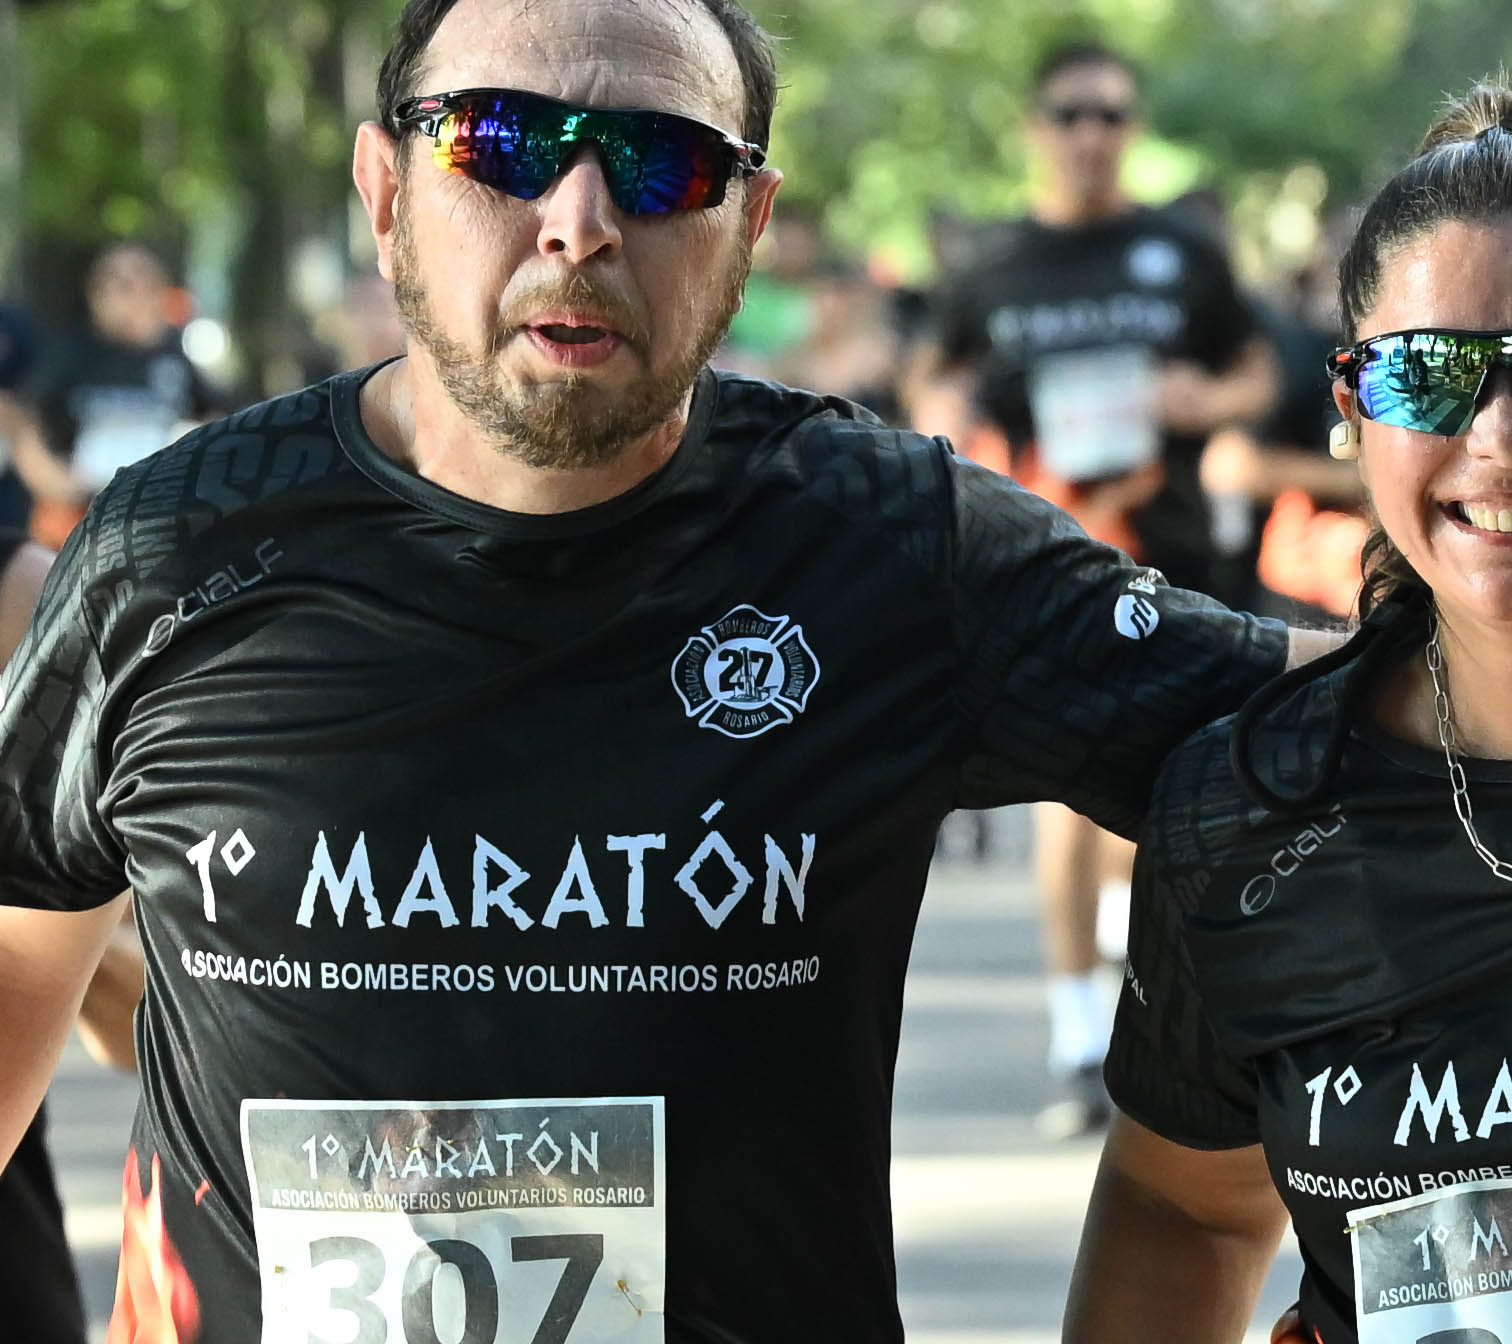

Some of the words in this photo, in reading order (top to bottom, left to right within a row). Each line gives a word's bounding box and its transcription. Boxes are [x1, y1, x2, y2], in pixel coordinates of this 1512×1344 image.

[718, 647, 774, 693] 27
[722, 710, 770, 729] ROSARIO
[295, 798, 817, 932] MARATÓN
[320, 962, 495, 992] BOMBEROS
[504, 964, 718, 993] VOLUNTARIOS
[726, 955, 820, 992] ROSARIO
[358, 1117, 600, 1179] MARATÓN
[271, 1188, 359, 1210] ASOCIACIÓN
[362, 1191, 451, 1210] BOMBEROS
[456, 1186, 567, 1208] VOLUNTARIOS
[573, 1186, 646, 1204] ROSARIO
[1287, 1167, 1412, 1201] ASOCIACIÓN
